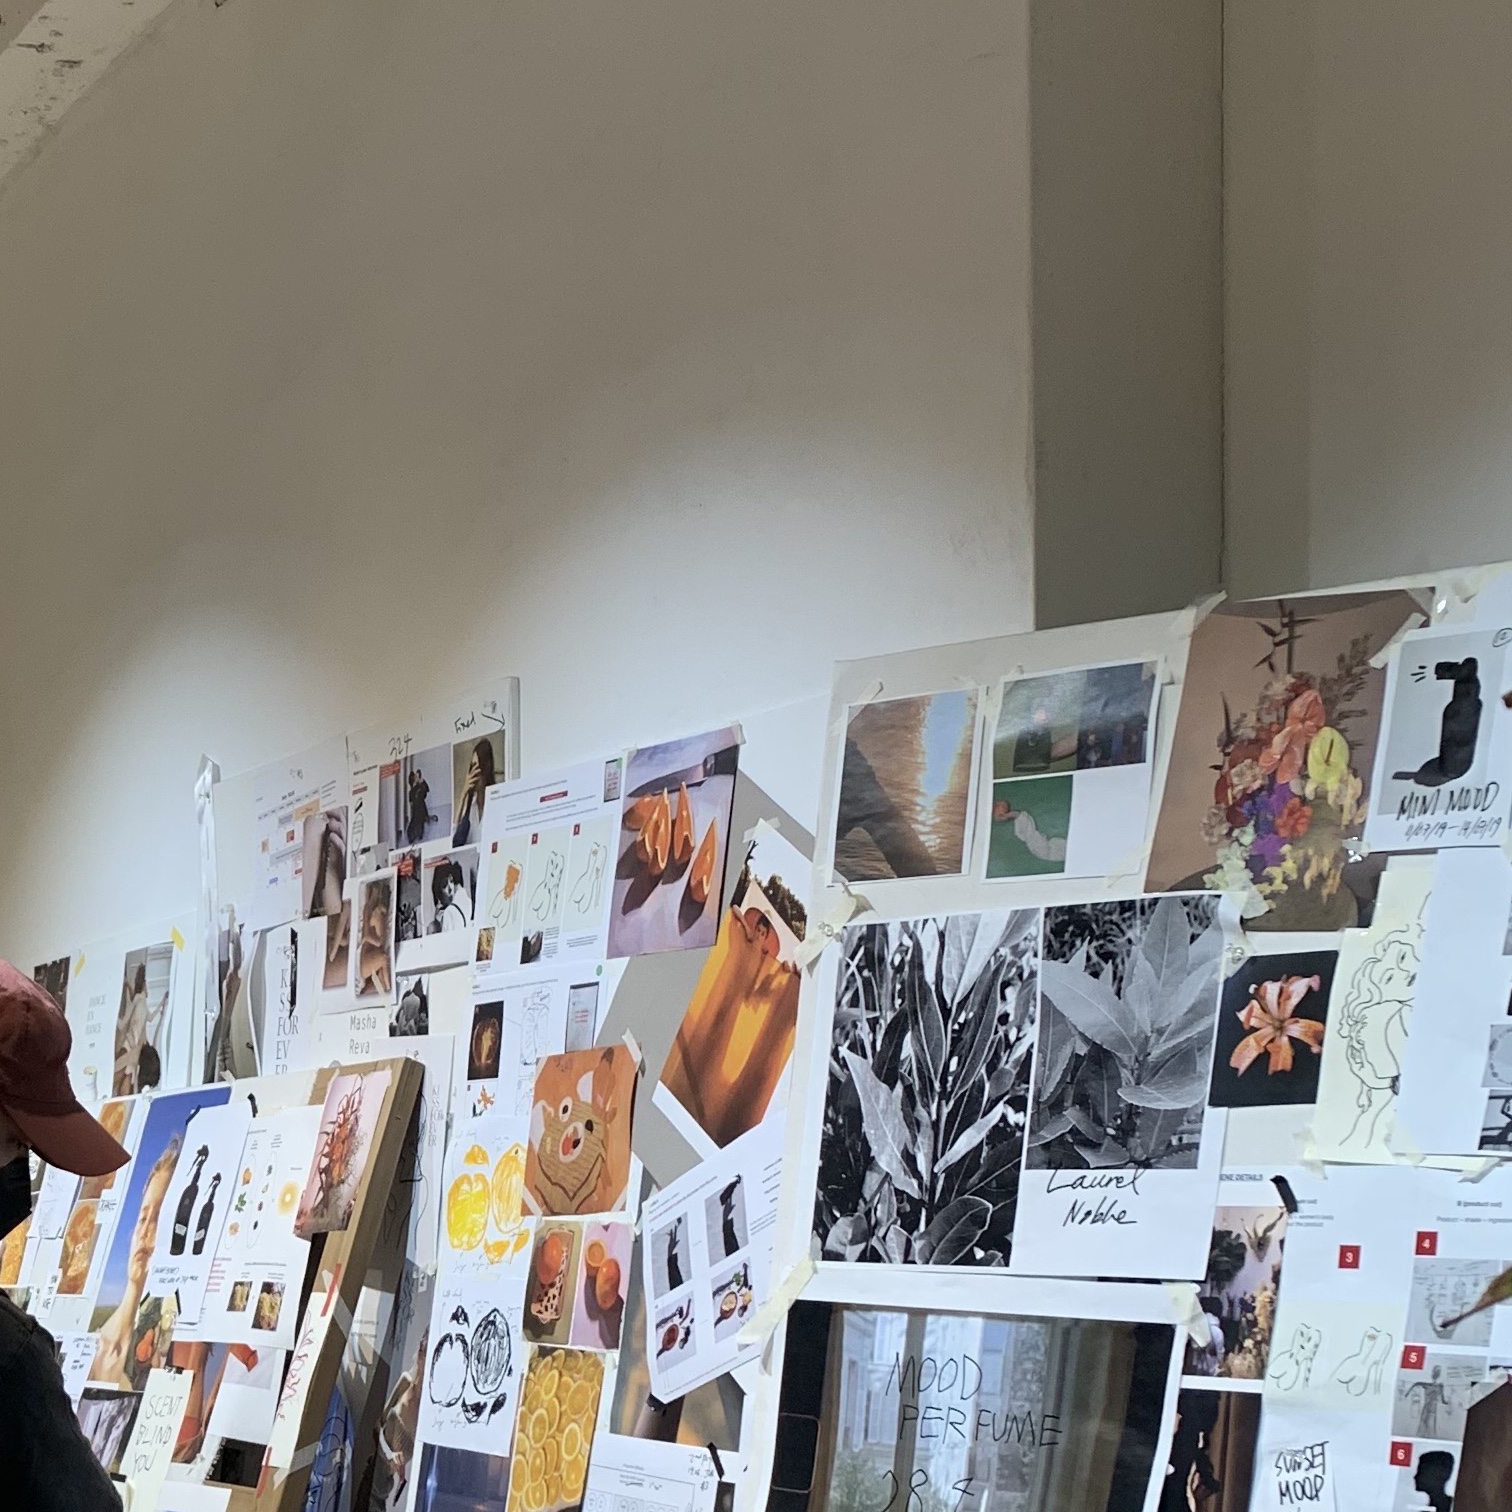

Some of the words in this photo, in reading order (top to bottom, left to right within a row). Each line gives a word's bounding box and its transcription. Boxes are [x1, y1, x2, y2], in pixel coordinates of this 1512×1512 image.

[1396, 788, 1441, 821] MINI
[277, 1015, 299, 1036] FOR
[350, 1013, 377, 1030] Masha
[275, 1040, 291, 1060] EV
[349, 1038, 370, 1054] Reva
[1046, 1168, 1145, 1196] Laurel
[1235, 1174, 1263, 1182] DETAILS
[1421, 1238, 1431, 1250] 4
[1345, 1251, 1354, 1263] 3
[1408, 1351, 1418, 1363] 5
[885, 1352, 983, 1400] MOOD
[144, 1395, 183, 1420] SCENT
[135, 1424, 172, 1447] BLIND
[899, 1405, 1062, 1447] PERFUME
[132, 1449, 158, 1473] YOU
[1396, 1448, 1405, 1460] 6
